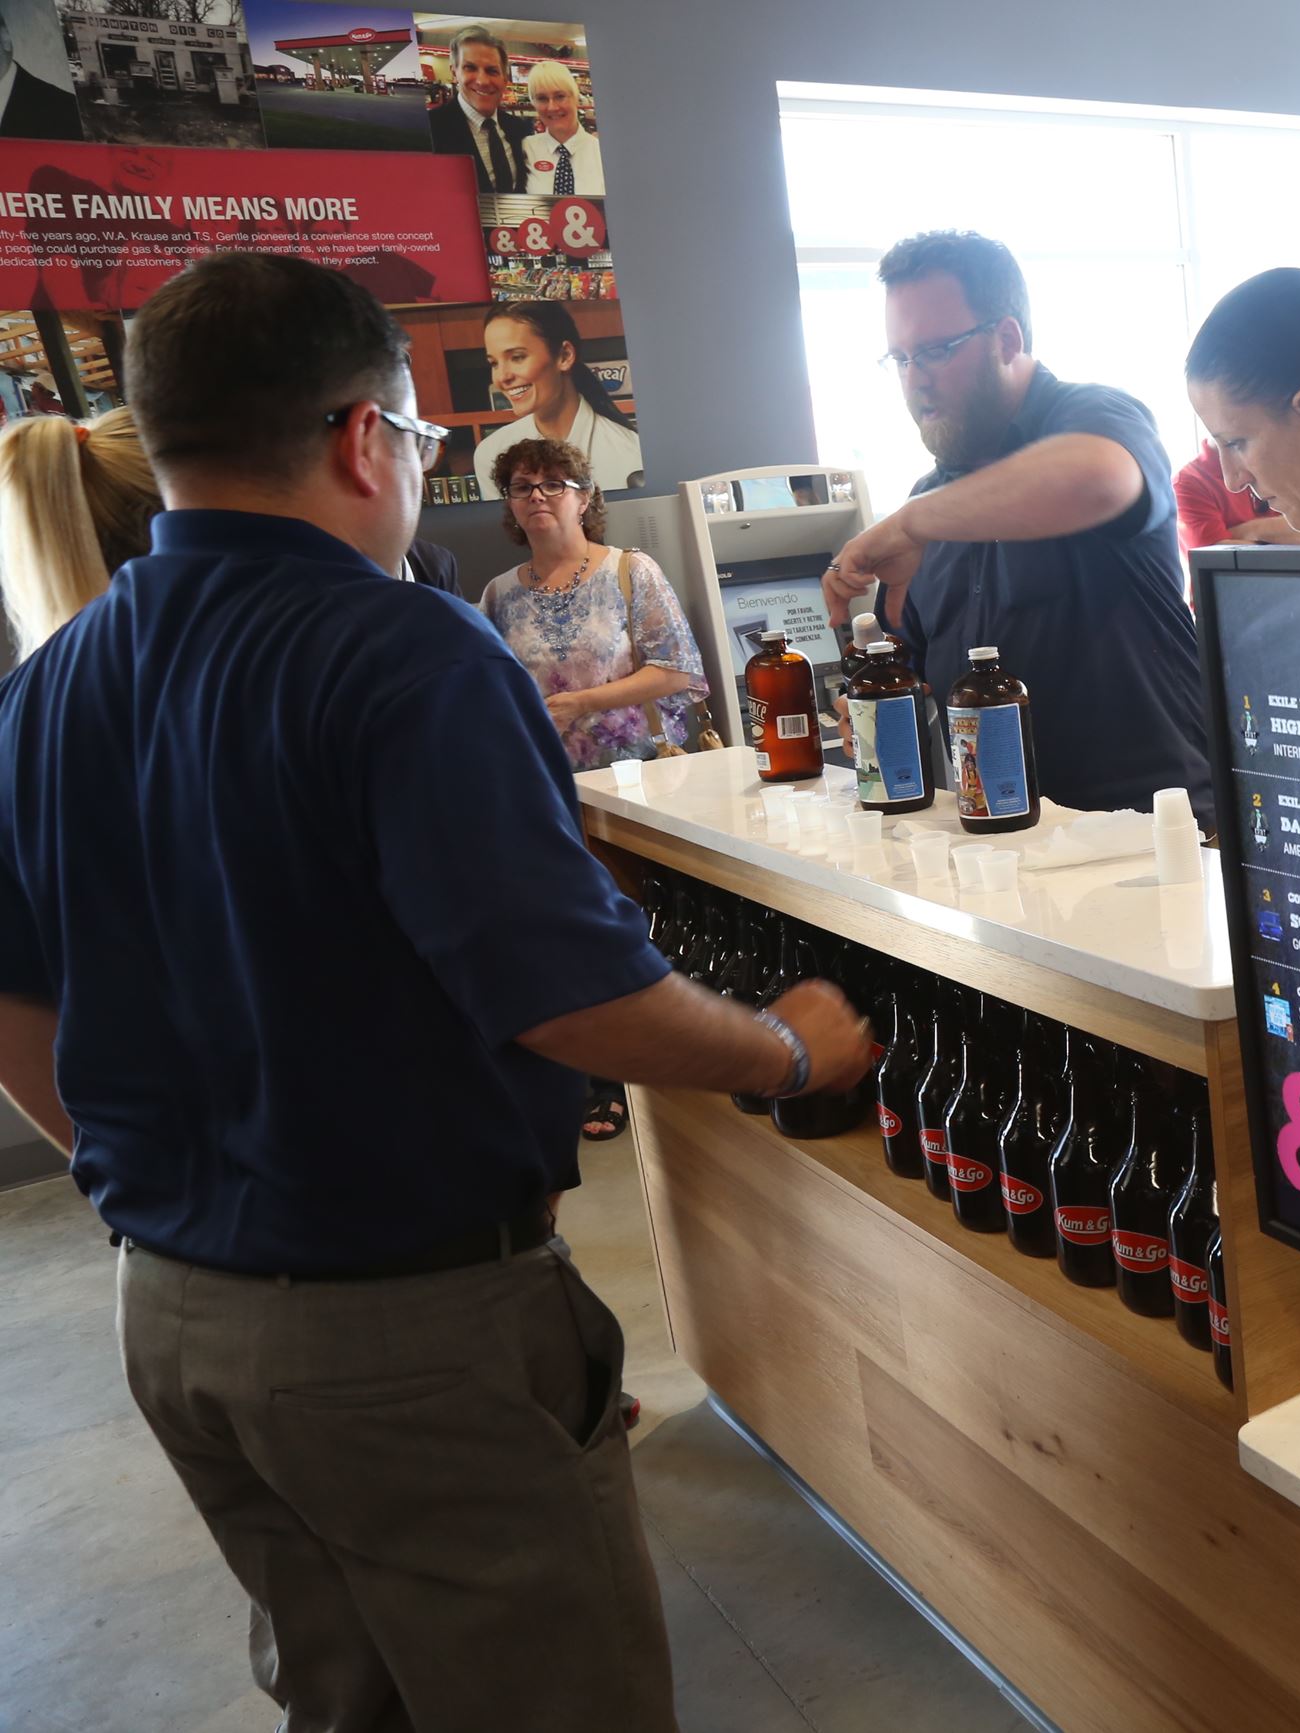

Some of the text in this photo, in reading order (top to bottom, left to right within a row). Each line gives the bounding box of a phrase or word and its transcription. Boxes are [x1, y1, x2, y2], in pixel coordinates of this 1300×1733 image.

[169, 25, 197, 36] OIL
[72, 194, 173, 219] FAMILY
[182, 196, 278, 220] MEANS
[284, 197, 359, 220] MORE
[497, 205, 600, 252] & & &
[42, 232, 72, 241] years
[102, 231, 129, 240] W.A.
[131, 231, 168, 240] Krause
[171, 231, 191, 240] and
[216, 231, 248, 240] Gentle
[251, 231, 299, 242] pioneered
[311, 232, 369, 240] convenience
[371, 232, 395, 240] store
[397, 231, 434, 241] concept
[5, 245, 43, 254] people
[46, 244, 77, 253] could
[80, 244, 129, 254] purchase
[132, 246, 151, 255] gas
[154, 244, 161, 253] &
[332, 244, 355, 252] have
[356, 244, 379, 252] been
[382, 243, 440, 253] family-owned
[55, 258, 67, 266] to
[70, 257, 102, 268] giving
[126, 258, 181, 266] customers
[322, 256, 342, 265] they
[345, 256, 379, 265] expect.
[737, 593, 798, 610] Bienvenido
[1243, 695, 1250, 709] 1
[1268, 695, 1298, 708] EXILE
[1253, 794, 1261, 807] 2
[921, 1135, 940, 1151] Kum
[958, 1169, 965, 1178] &
[966, 1167, 984, 1182] Go
[1017, 1189, 1034, 1204] Go
[1058, 1212, 1095, 1231] Kum &
[1112, 1237, 1167, 1262] Kum & Go
[1190, 1275, 1208, 1293] Go
